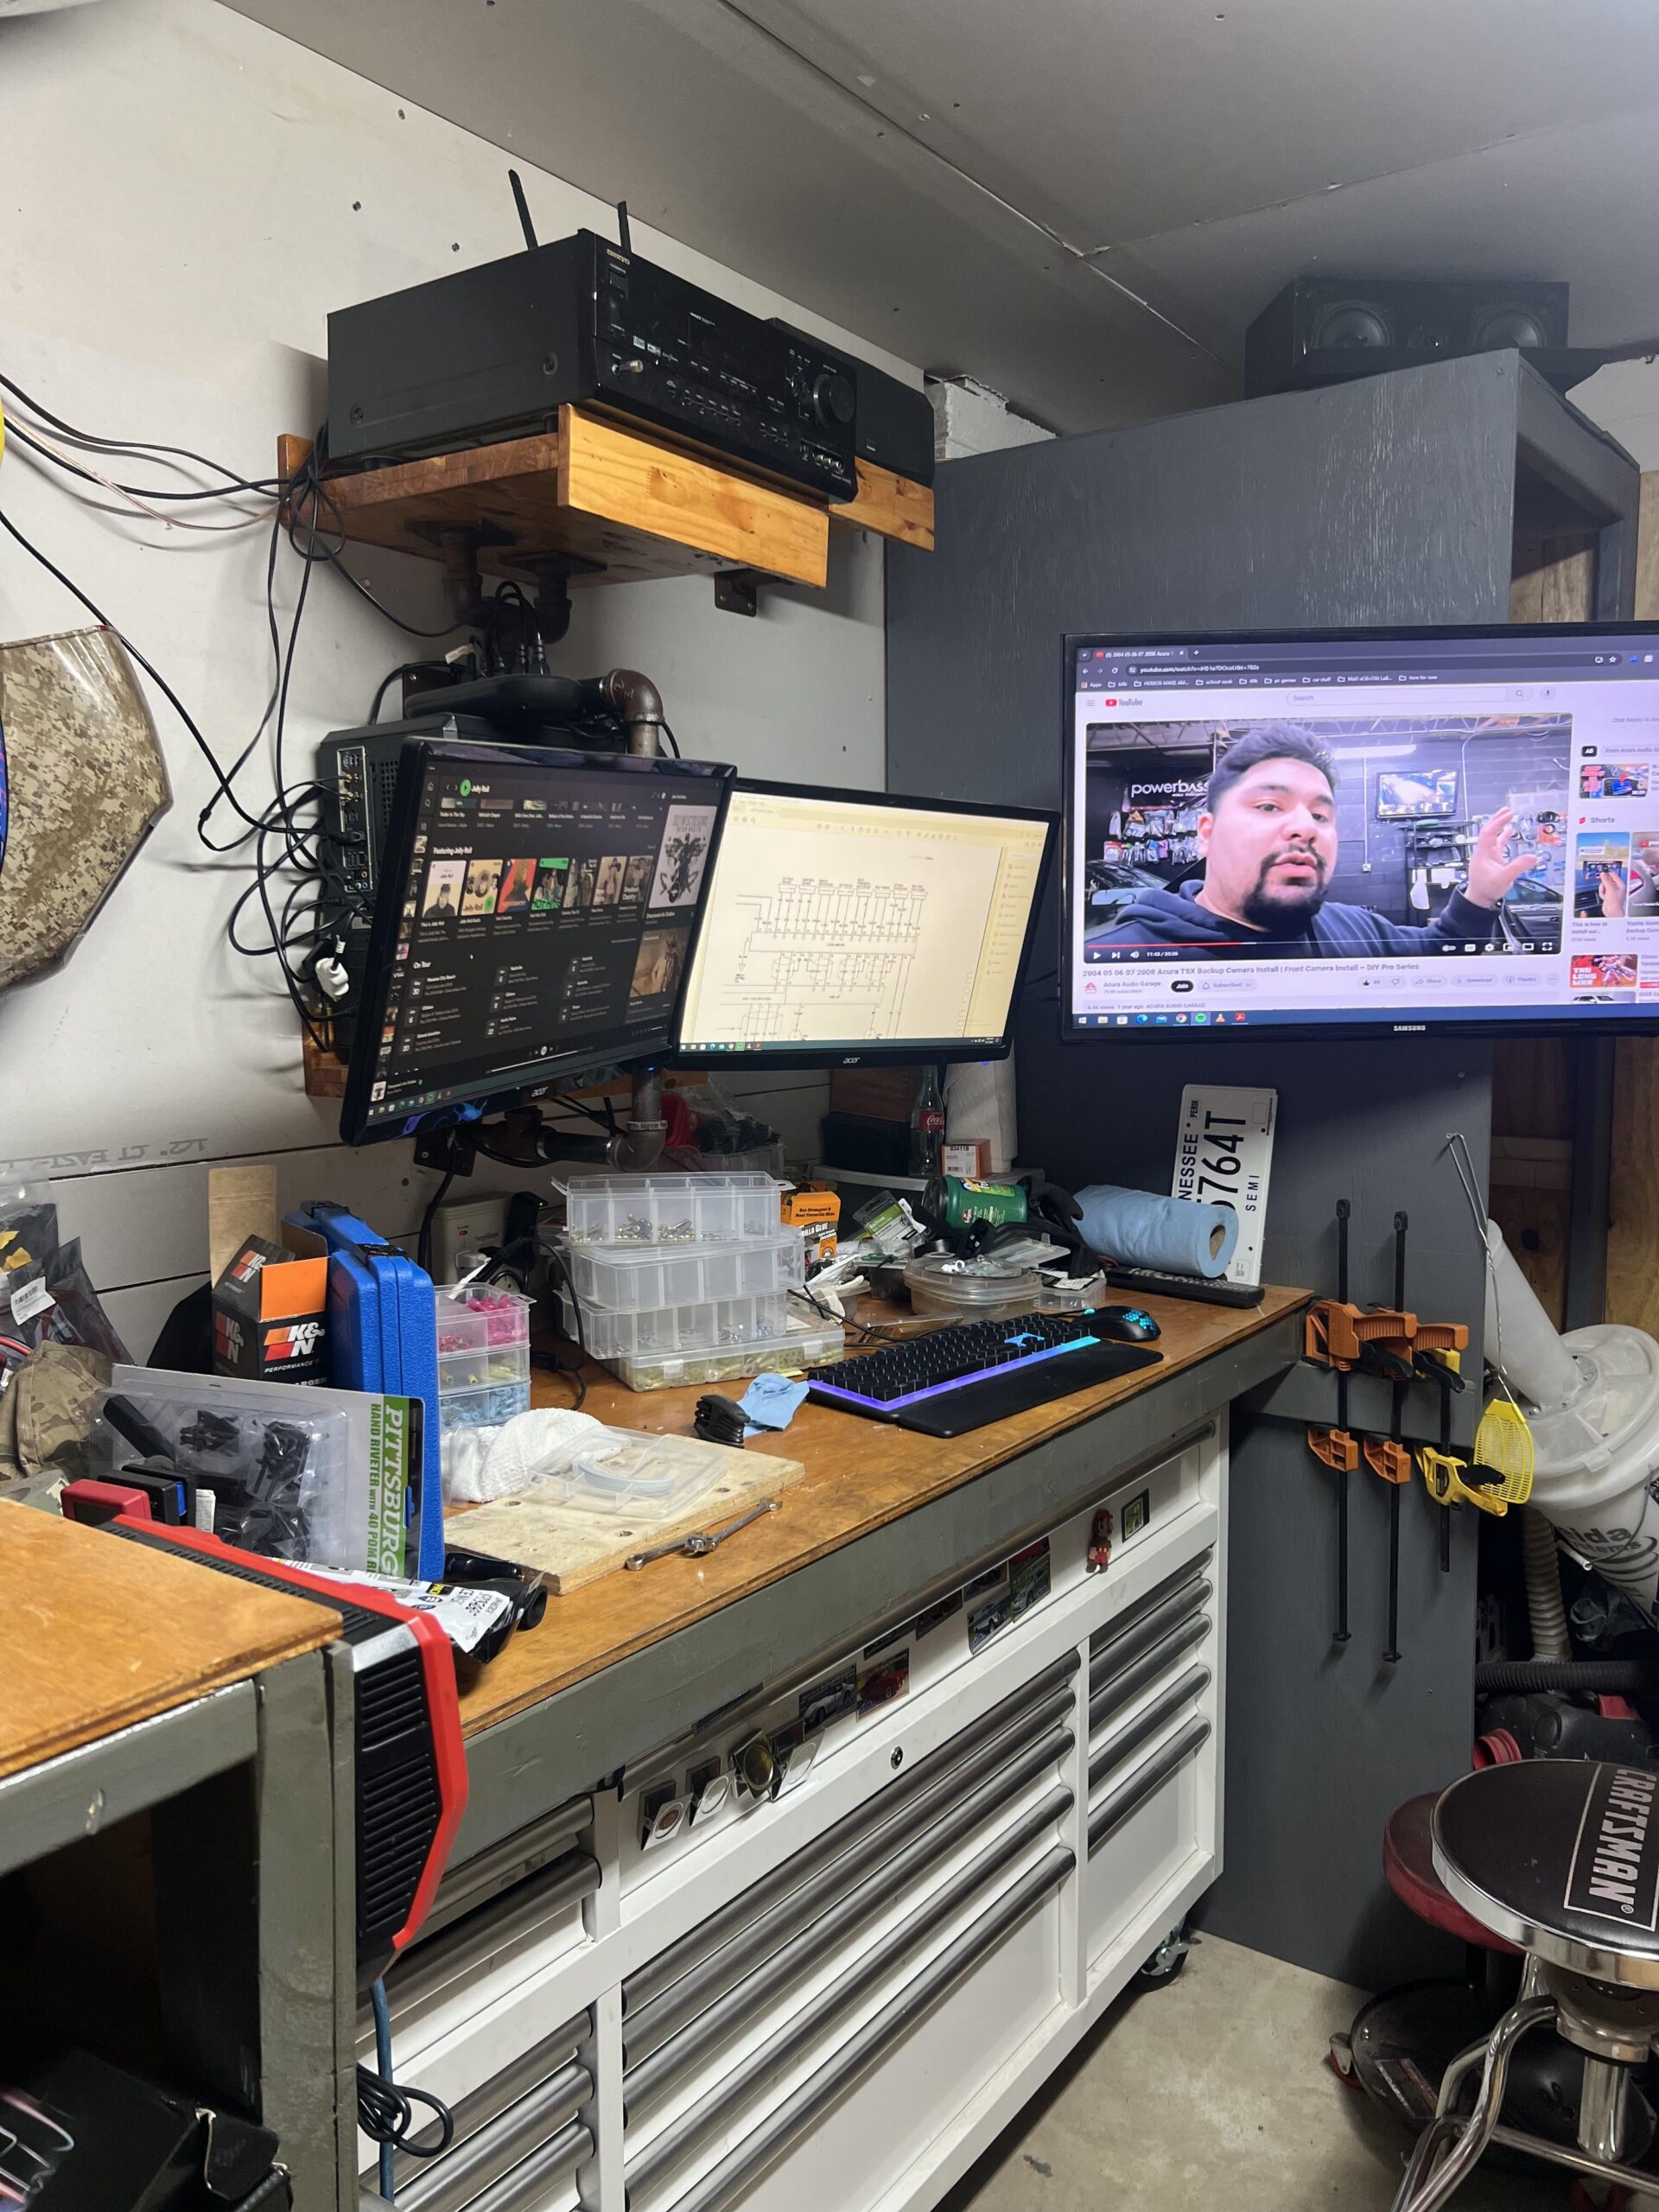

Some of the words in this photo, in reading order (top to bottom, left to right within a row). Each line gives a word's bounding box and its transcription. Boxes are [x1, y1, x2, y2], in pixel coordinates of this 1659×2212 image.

[1118, 698, 1143, 707] YouTube
[531, 1086, 549, 1097] acer
[1189, 1100, 1199, 1118] PERM
[1245, 1175, 1260, 1211] SEMI
[815, 1222, 829, 1232] GLUE
[264, 1360, 315, 1374] PERFORMANCE
[370, 1403, 381, 1436] HAND
[369, 1438, 381, 1487] RIVETER
[368, 1489, 377, 1510] WITH
[368, 1514, 379, 1529] 40
[1589, 1769, 1657, 1905] CRAFTSMAN
